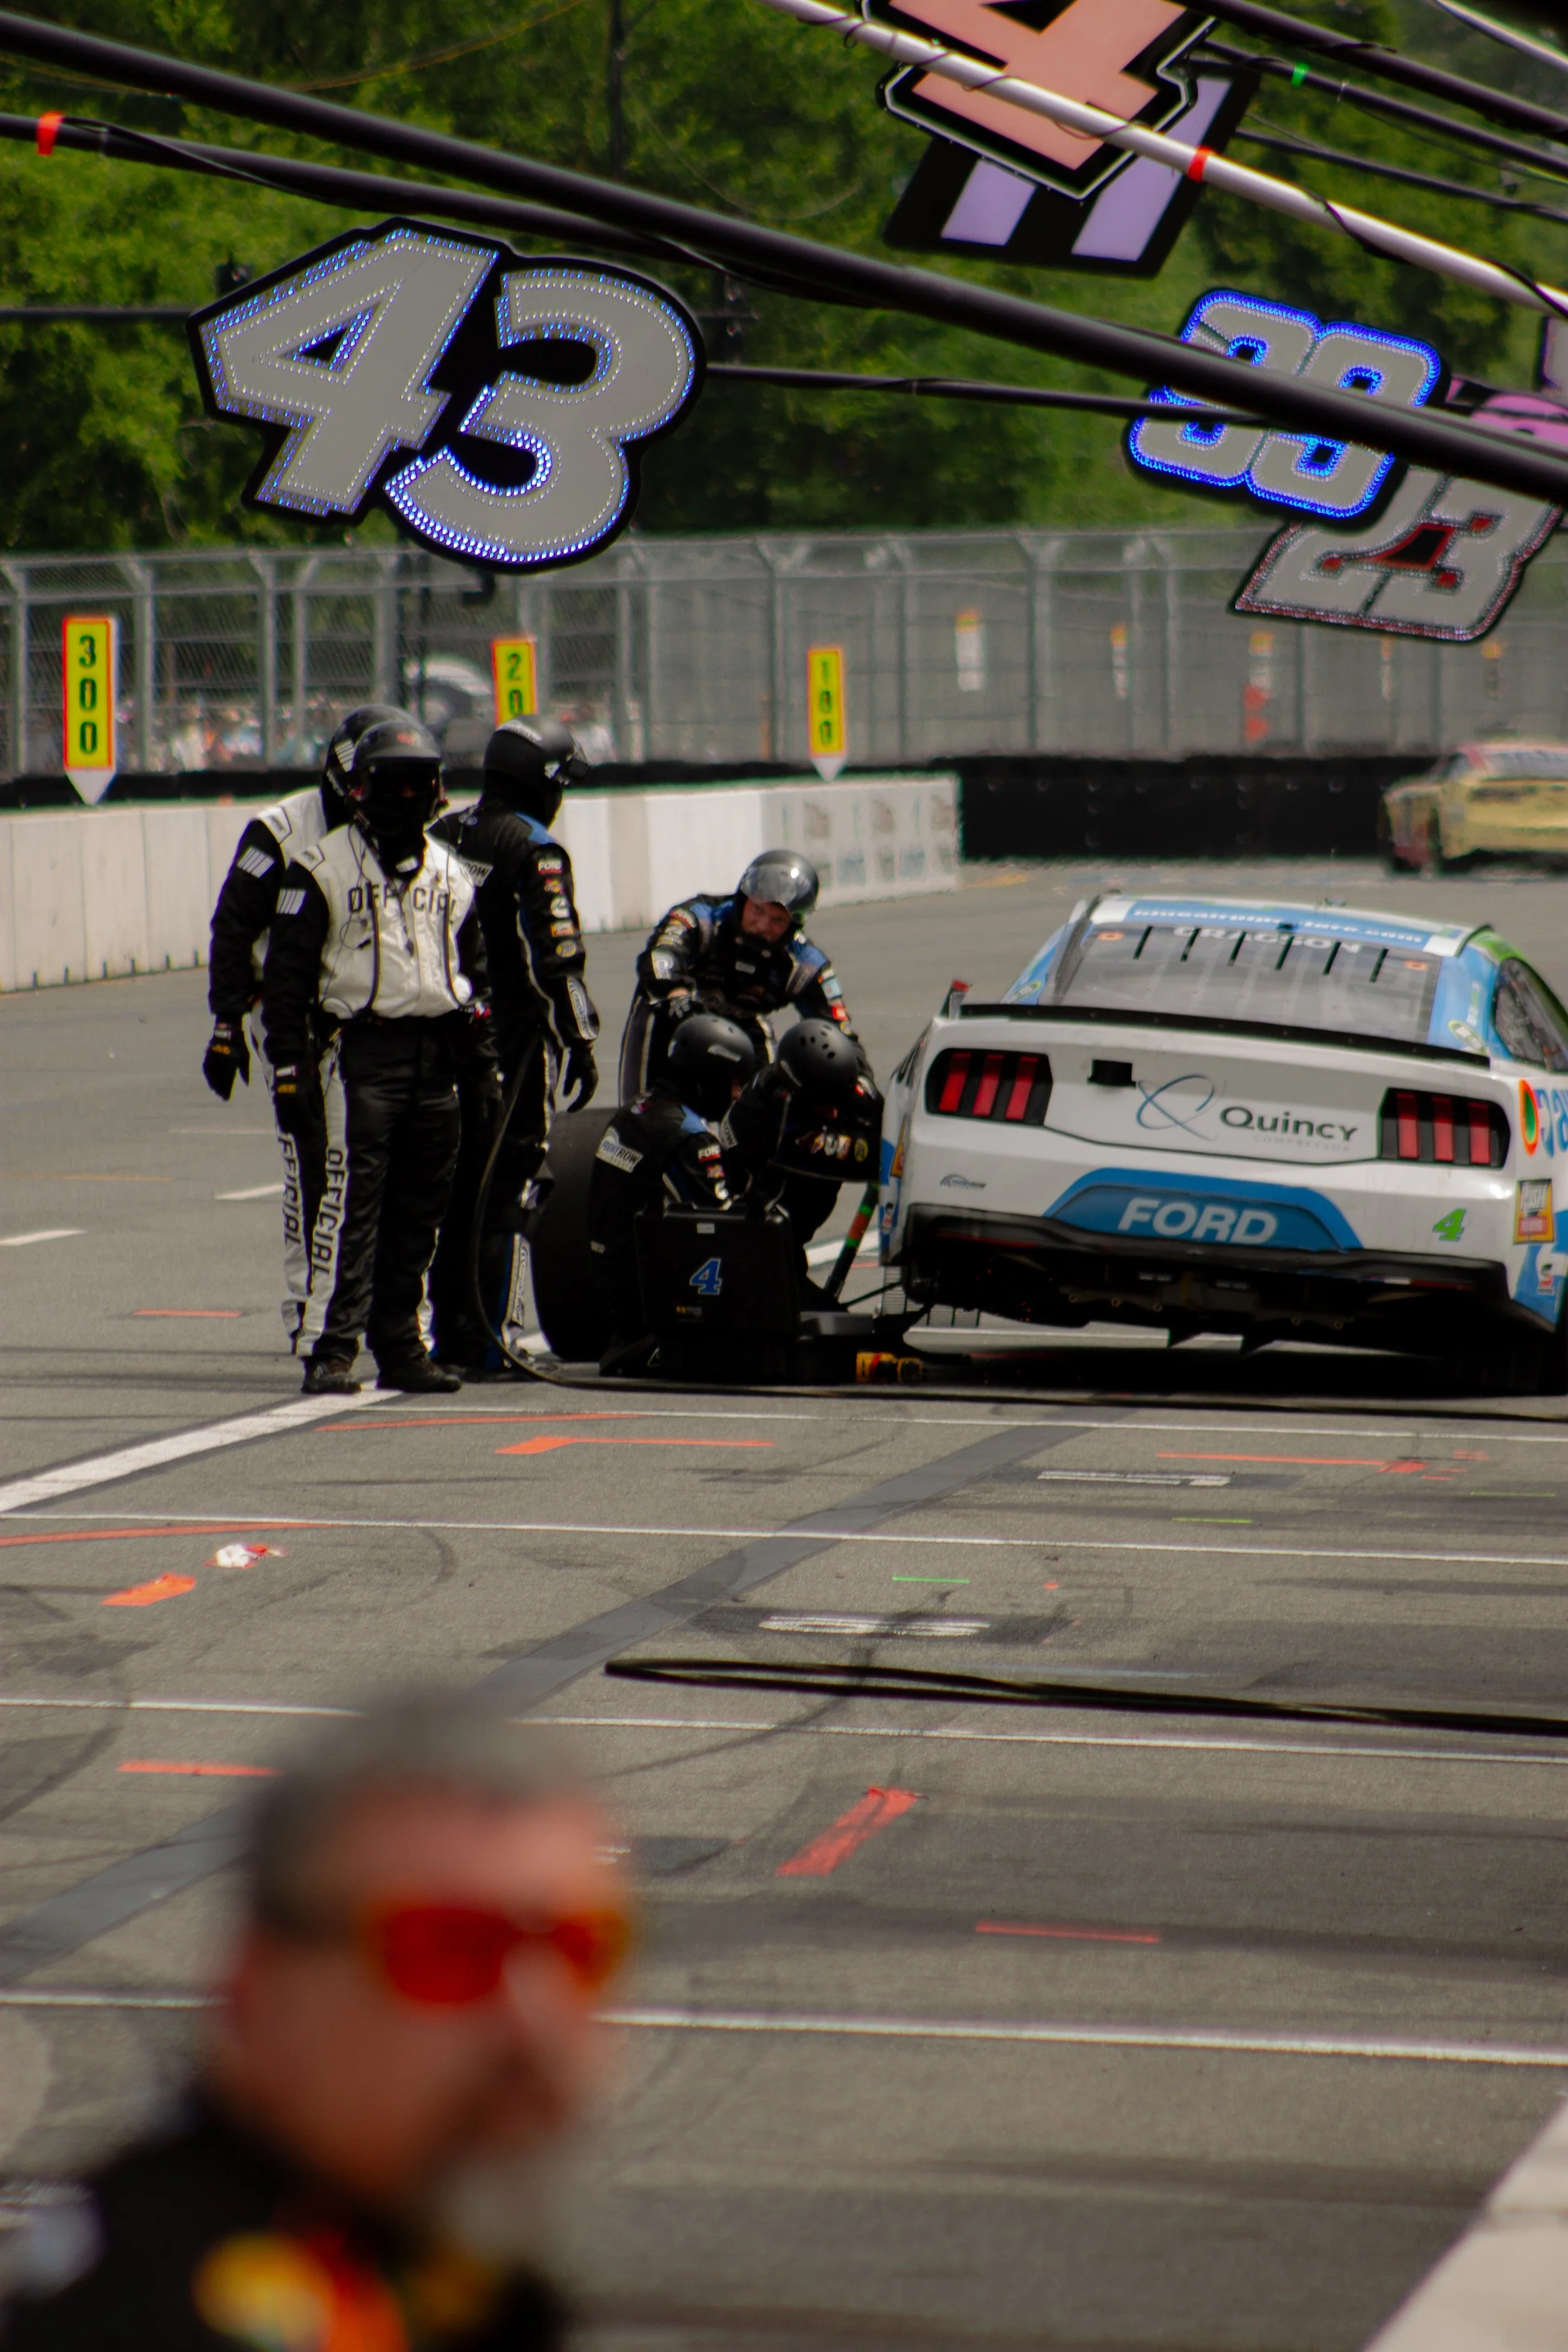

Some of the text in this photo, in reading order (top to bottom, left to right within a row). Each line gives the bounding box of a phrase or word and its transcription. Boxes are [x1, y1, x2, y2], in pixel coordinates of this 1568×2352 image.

[199, 227, 696, 564] 43
[1236, 467, 1563, 641] 23
[79, 635, 97, 755] 300
[507, 652, 523, 715] 20
[820, 660, 832, 746] 100
[278, 1133, 302, 1246] FFICIAL
[312, 1149, 345, 1276] OFFICIAL
[1118, 1197, 1278, 1244] FORD
[1432, 1208, 1466, 1242] 4
[689, 1258, 722, 1295] 4
